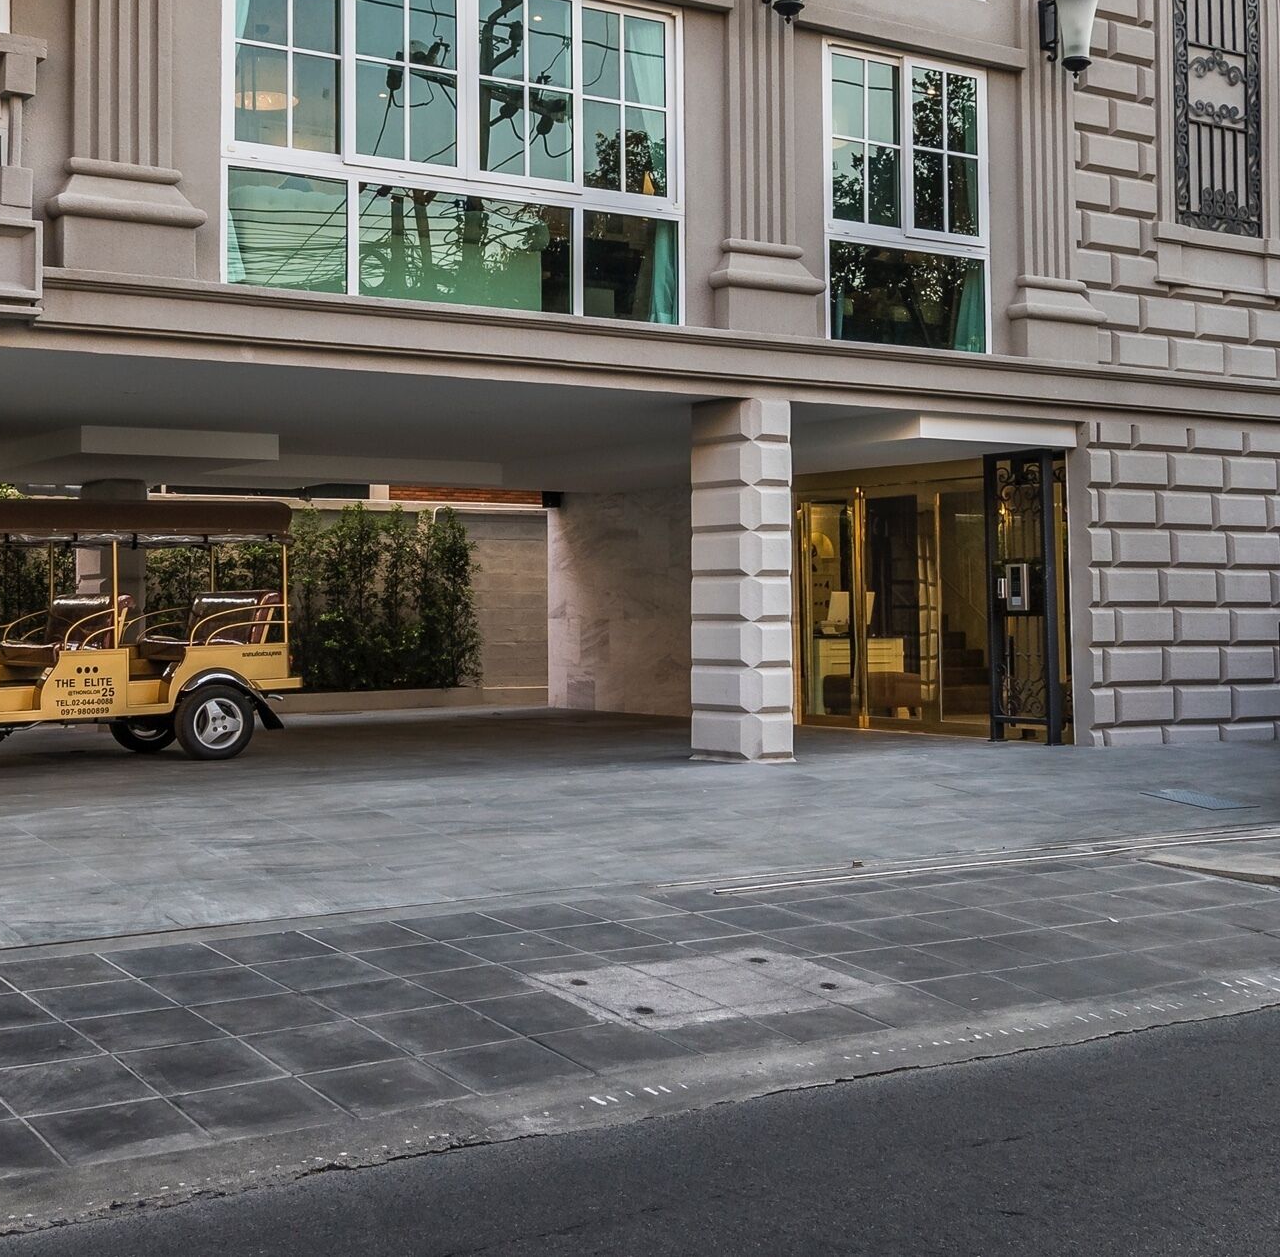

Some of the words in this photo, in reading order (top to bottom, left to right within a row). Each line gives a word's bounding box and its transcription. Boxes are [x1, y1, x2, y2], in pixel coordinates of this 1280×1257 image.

[55, 678, 76, 688] THE
[84, 677, 113, 687] ELITE
[101, 687, 115, 697] 25
[61, 707, 110, 716] 097-9800899
